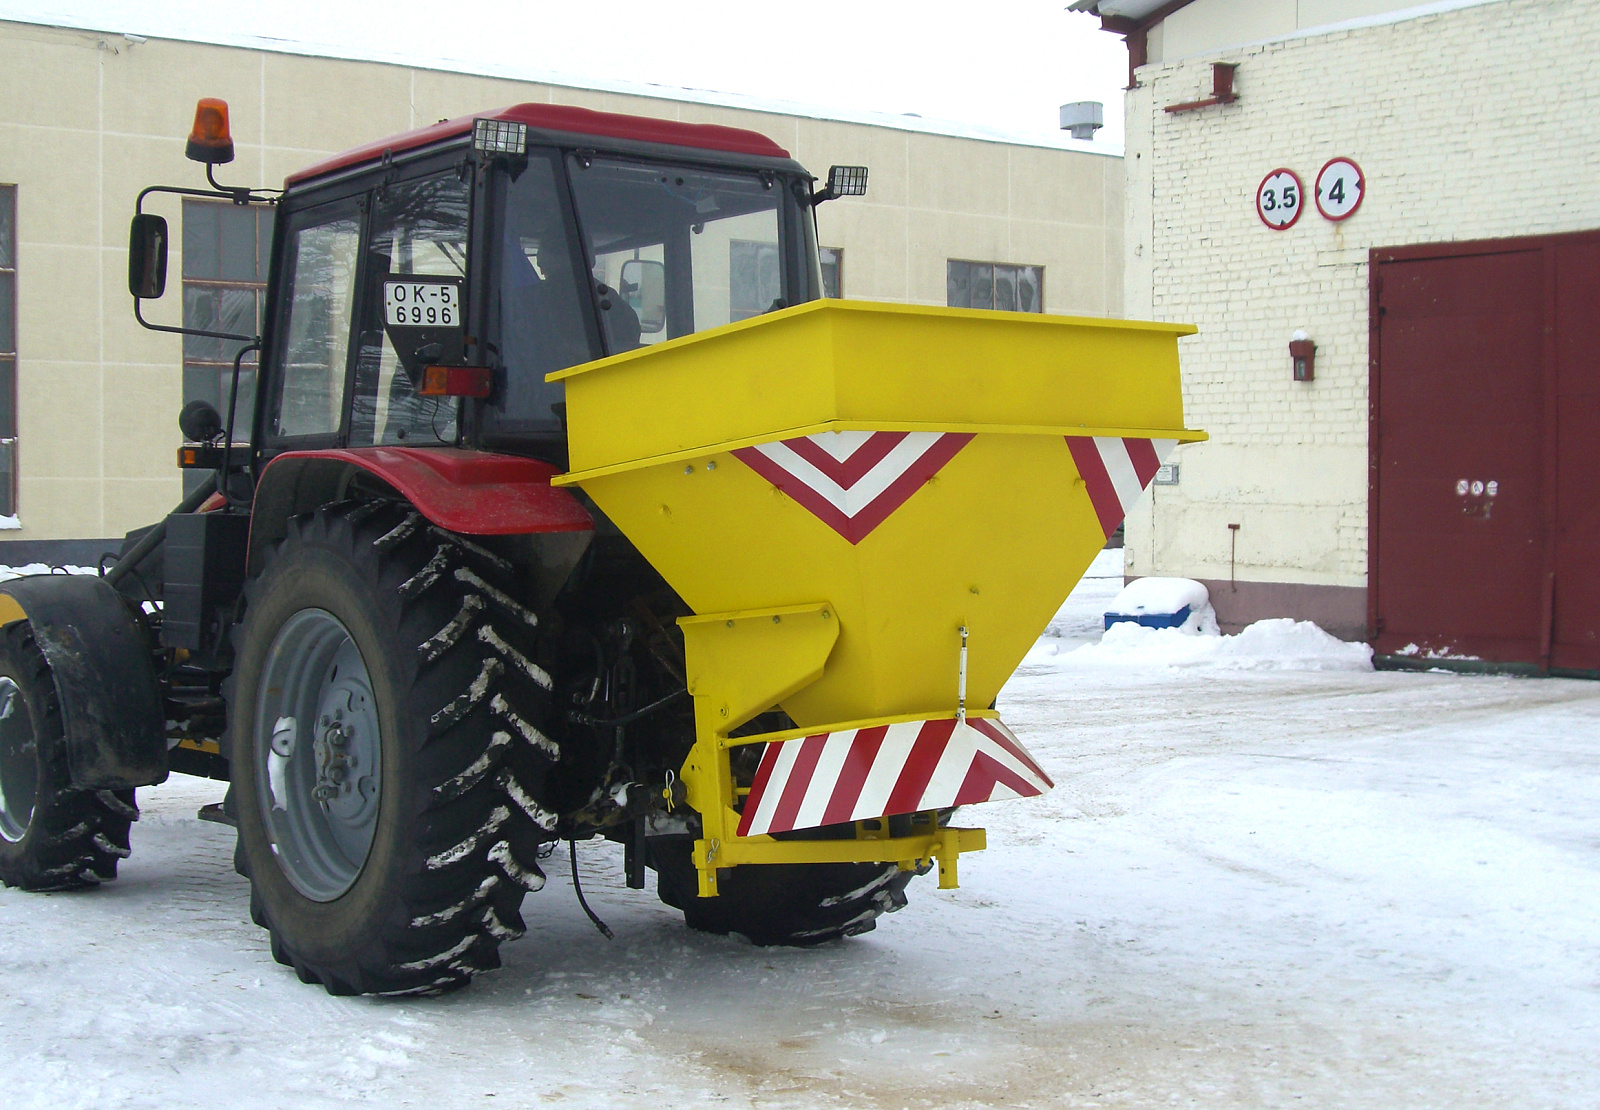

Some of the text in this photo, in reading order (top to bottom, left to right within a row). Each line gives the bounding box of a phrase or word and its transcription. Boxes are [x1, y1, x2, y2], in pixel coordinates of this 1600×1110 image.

[1263, 186, 1296, 211] 3.5
[1328, 177, 1345, 204] 4
[396, 306, 451, 324] 6996
